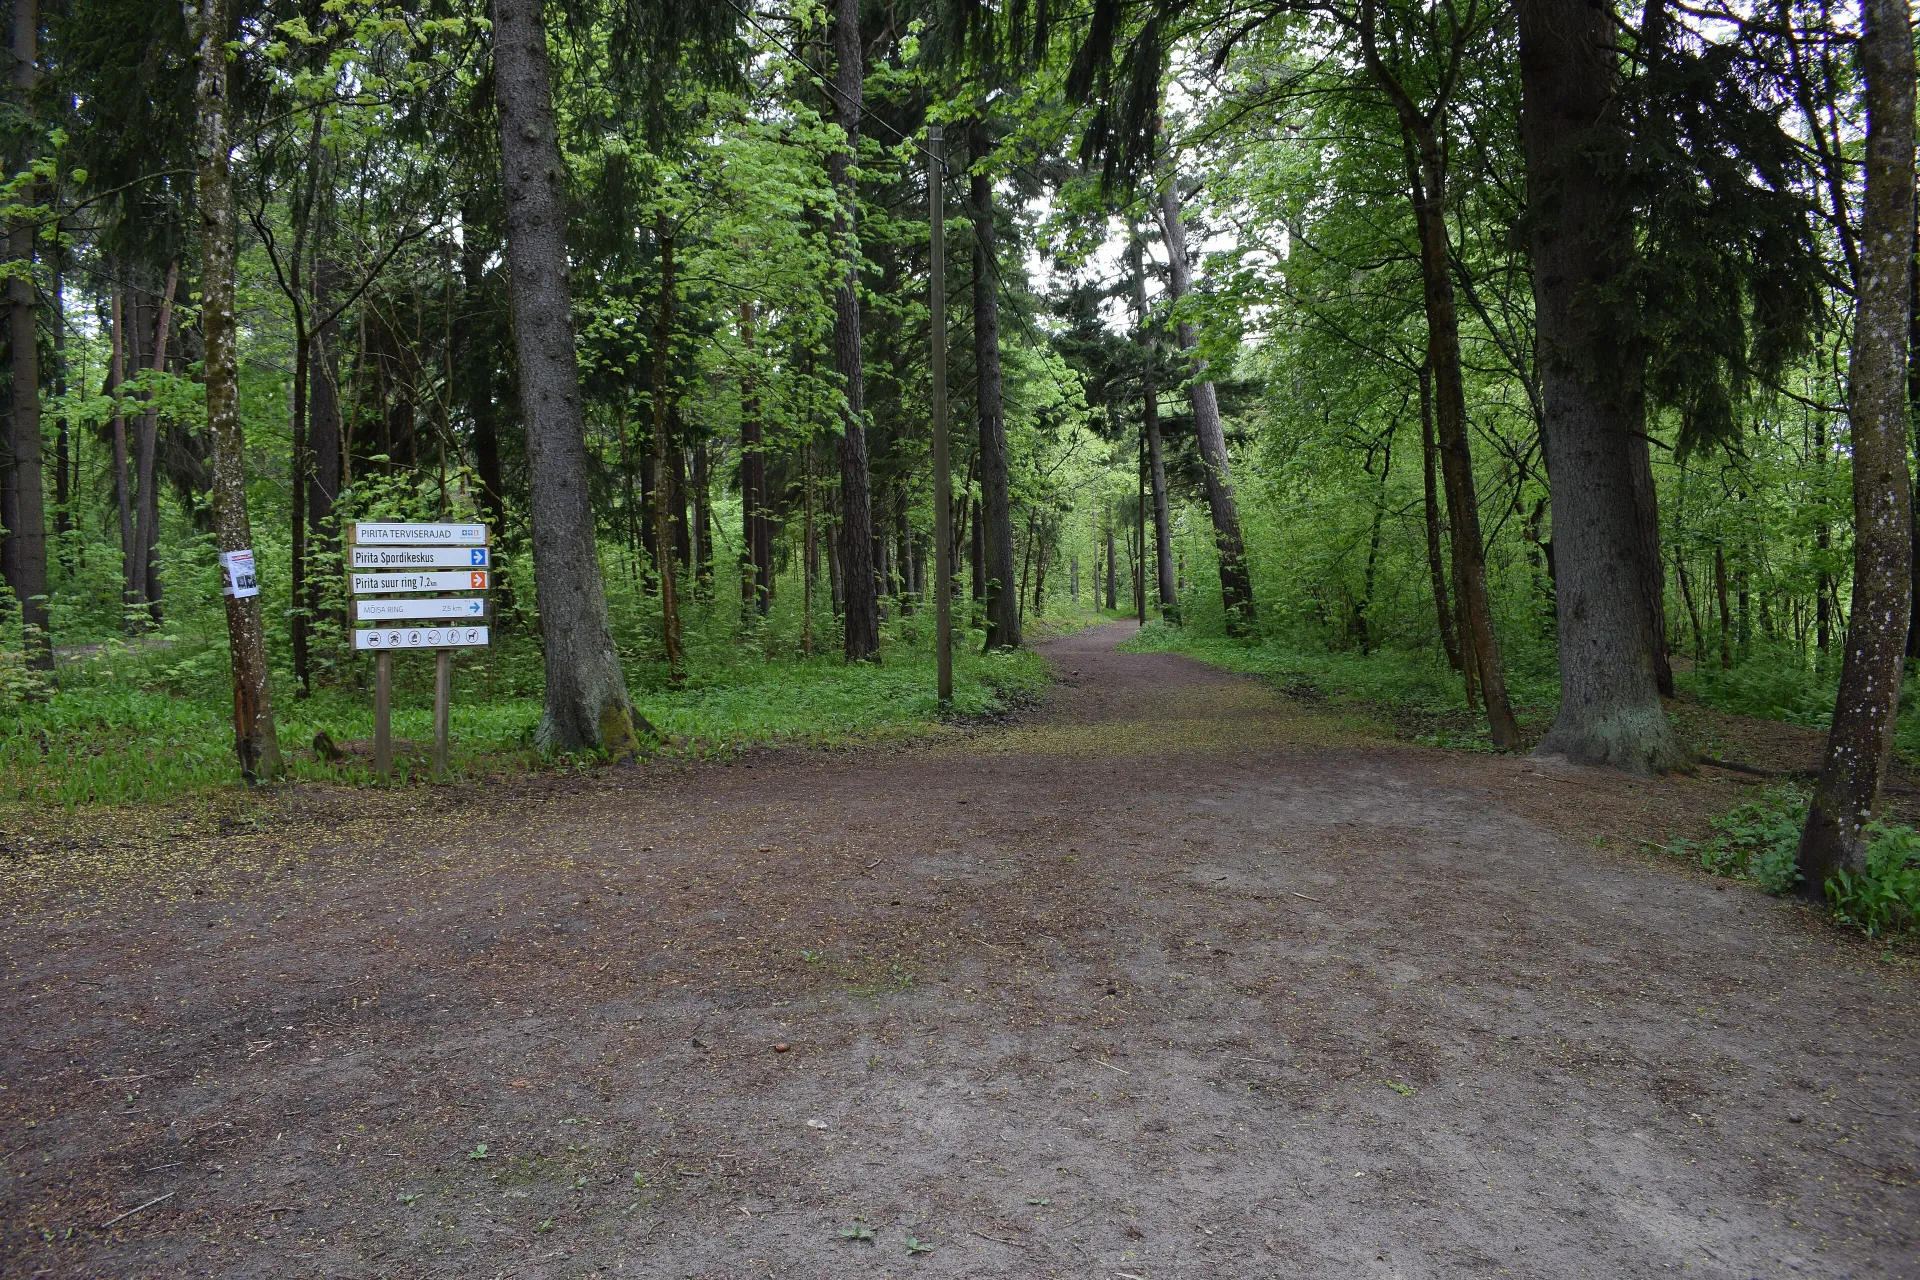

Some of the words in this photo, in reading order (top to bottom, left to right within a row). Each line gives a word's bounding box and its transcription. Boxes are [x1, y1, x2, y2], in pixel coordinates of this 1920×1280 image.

[361, 530, 388, 538] PIRITA
[389, 530, 452, 538] TERVISERAJAD
[355, 552, 379, 564] Pirita
[381, 552, 434, 565] Spordikeskus
[355, 577, 379, 589] Pirita
[381, 578, 399, 588] suur
[401, 577, 417, 589] ring
[363, 605, 386, 614] MÕISA
[387, 605, 404, 613] RING
